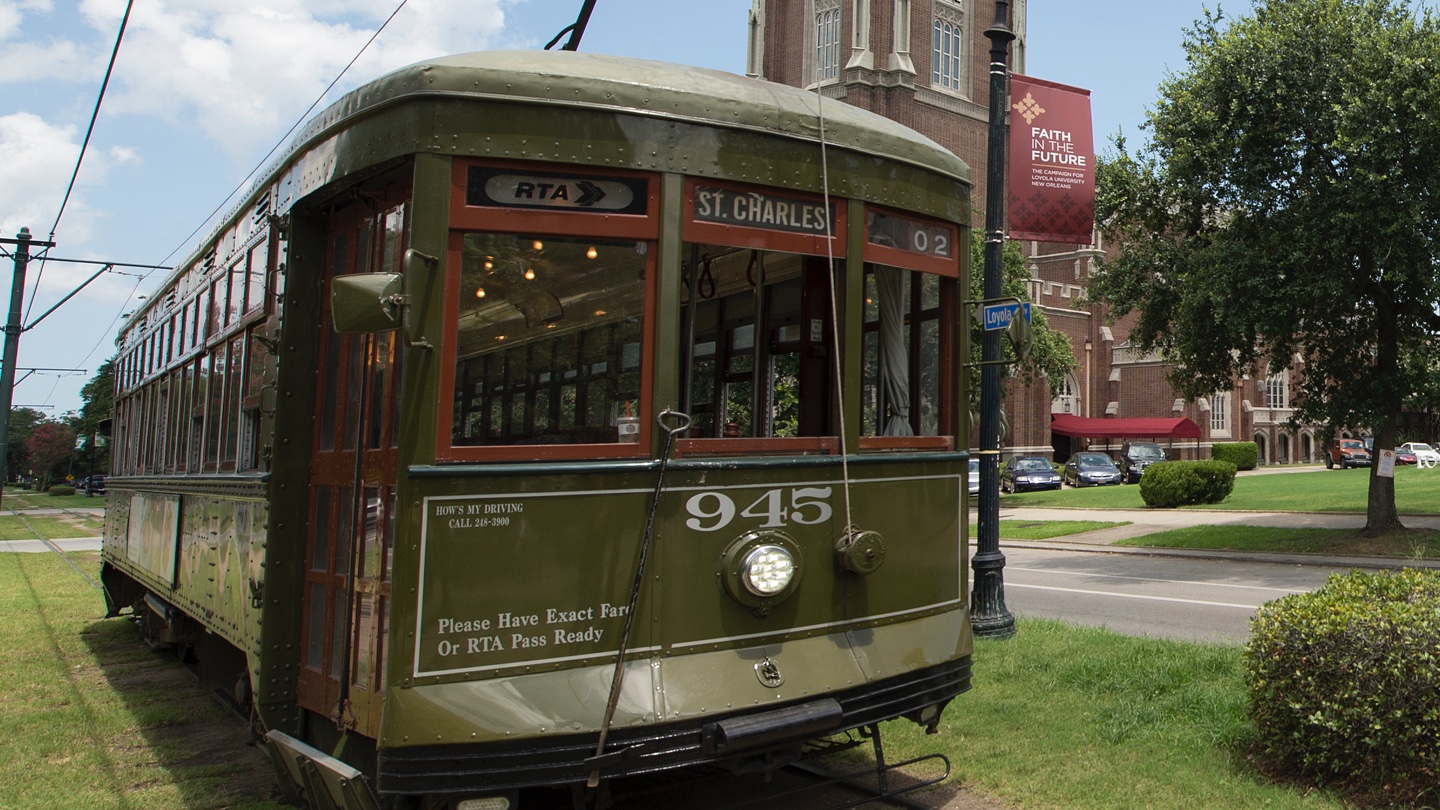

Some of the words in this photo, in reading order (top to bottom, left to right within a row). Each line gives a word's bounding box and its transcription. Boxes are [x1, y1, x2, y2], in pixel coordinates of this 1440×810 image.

[1031, 127, 1071, 142] FAITH
[1031, 138, 1045, 150] IN
[1048, 140, 1075, 154] THE
[1031, 150, 1086, 167] FUTURE
[1043, 169, 1072, 177] CAMPAIGN
[1054, 177, 1085, 185] UNIVERSITY
[514, 182, 569, 201] RTA
[1045, 182, 1072, 190] ORLEANS
[698, 190, 728, 219] ST.
[733, 194, 826, 230] CHARLES
[986, 307, 1012, 327] Loyola
[436, 505, 464, 516] HOW'S
[467, 504, 481, 515] MY
[484, 503, 524, 514] DRIVING
[685, 486, 833, 532] 945
[448, 518, 473, 529] CALL
[438, 618, 491, 634] Please
[497, 612, 539, 629] Have
[546, 606, 594, 624] Exact
[438, 640, 460, 657] Or
[467, 635, 504, 654] RTA
[511, 633, 547, 650] Pass
[554, 626, 604, 646] Ready
